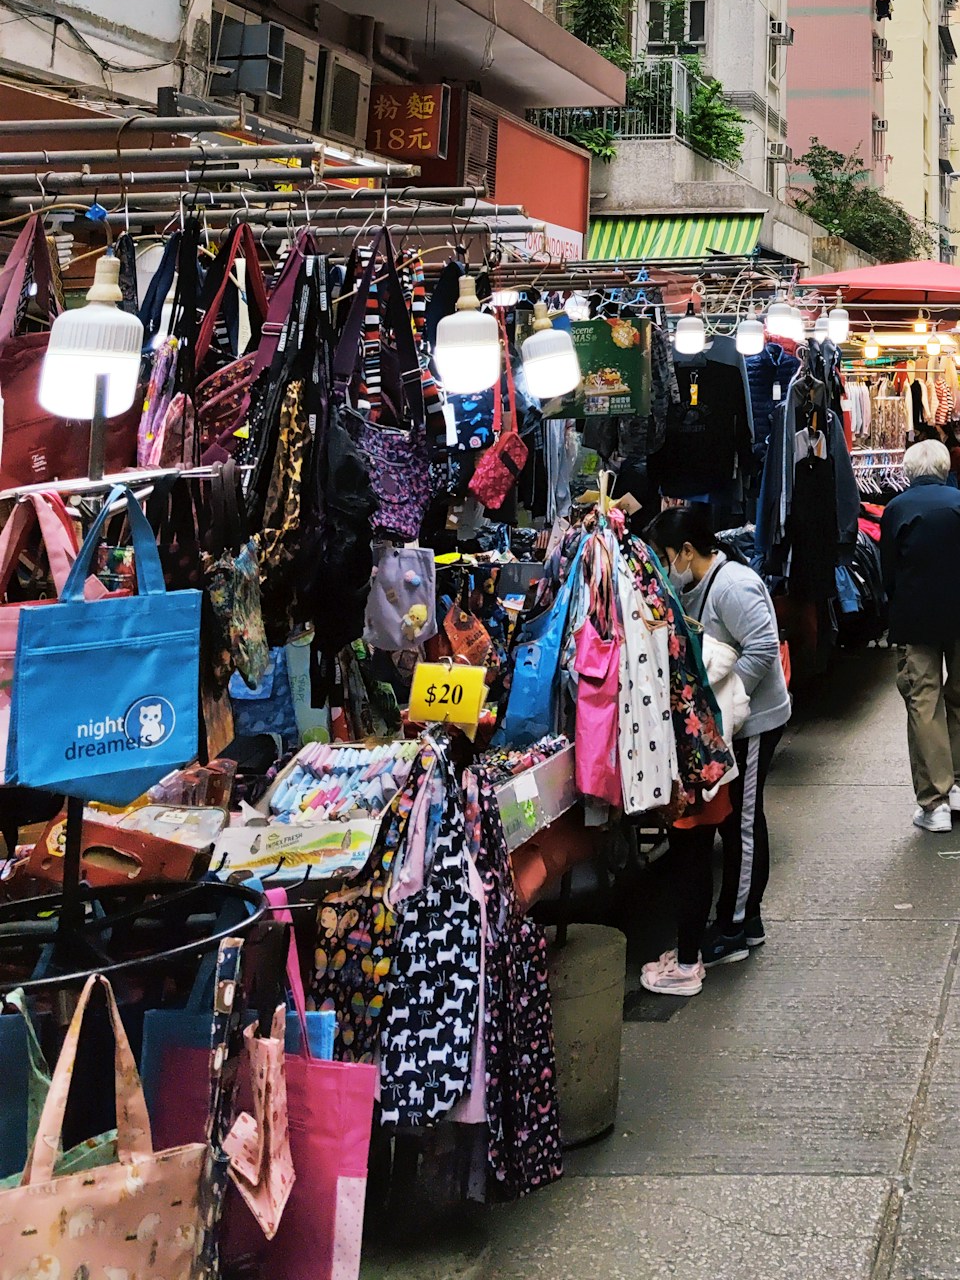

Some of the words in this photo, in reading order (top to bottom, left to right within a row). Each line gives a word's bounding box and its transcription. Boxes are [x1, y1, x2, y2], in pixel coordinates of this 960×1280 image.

[373, 92, 436, 120] 粉麵
[373, 128, 431, 150] 18元
[571, 327, 594, 335] Scene
[424, 683, 463, 707] $20
[77, 716, 124, 740] night
[65, 734, 153, 760] dreamers
